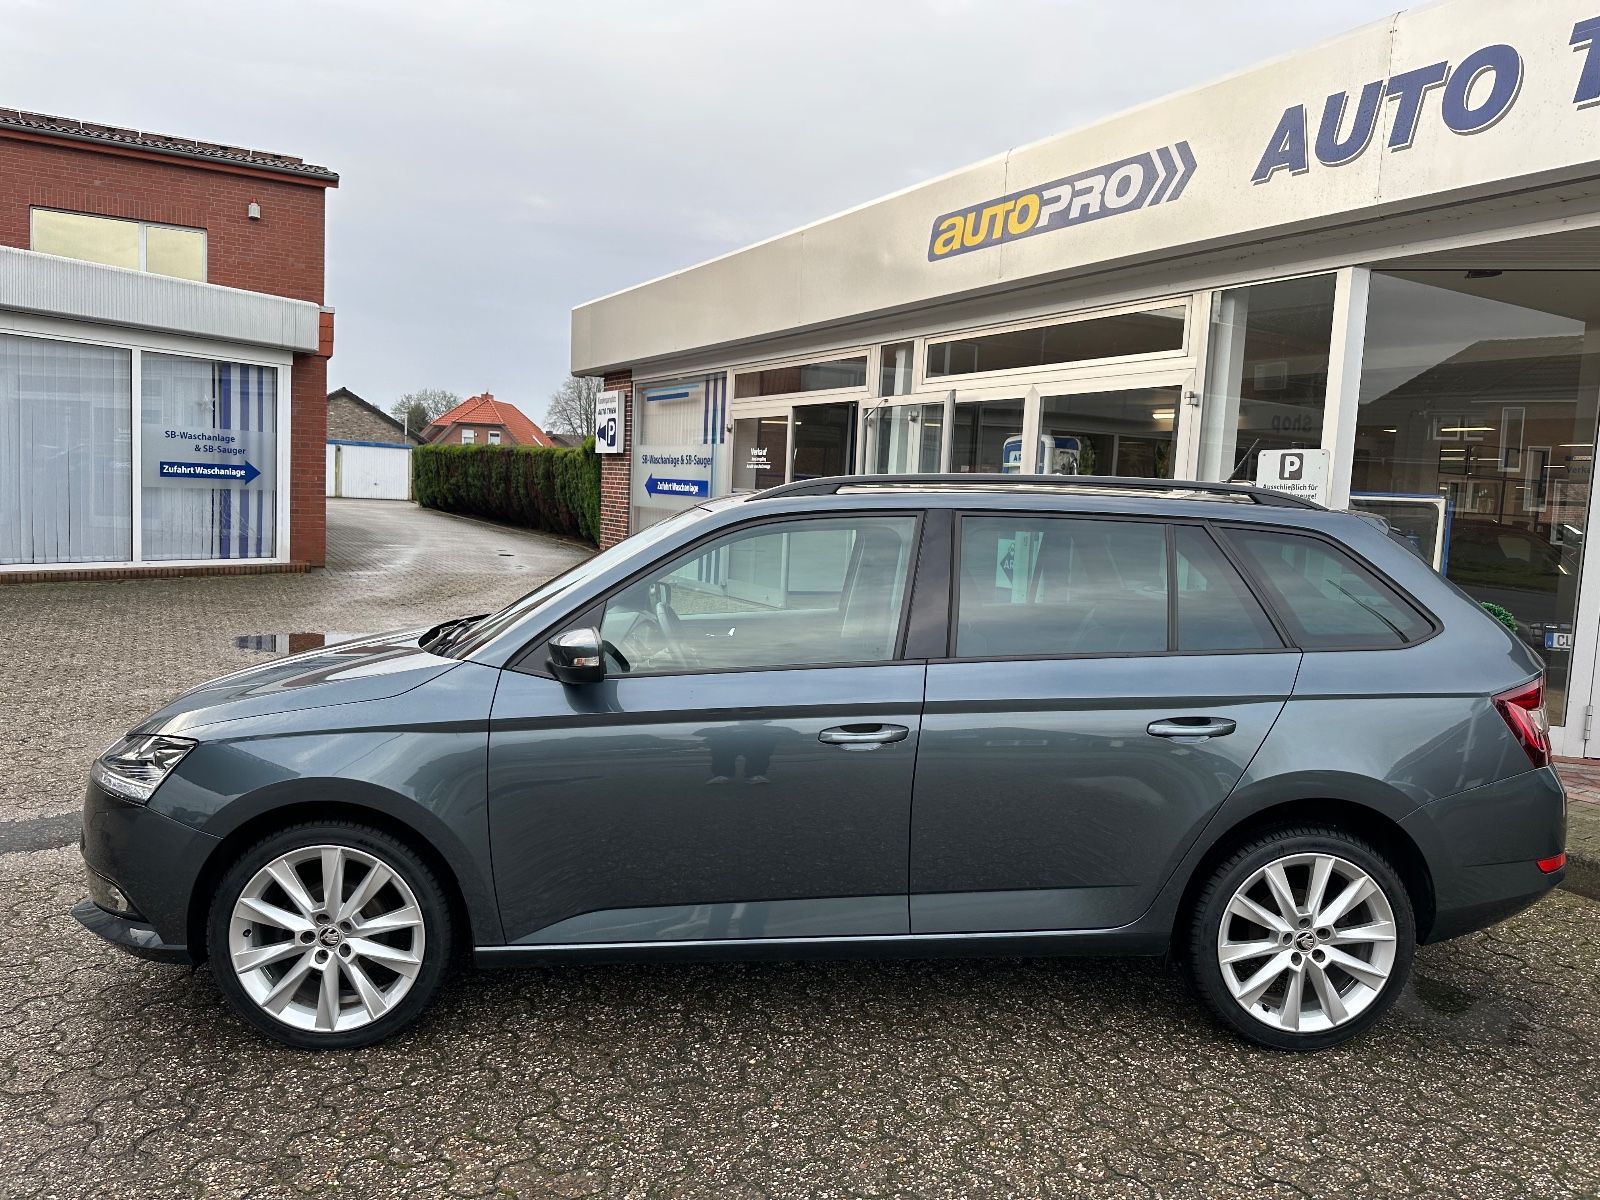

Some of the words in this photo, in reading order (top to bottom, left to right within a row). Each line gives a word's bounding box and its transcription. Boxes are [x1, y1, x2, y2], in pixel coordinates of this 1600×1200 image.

[1252, 44, 1523, 184] AUTO
[164, 430, 236, 444] SB-Waschanlage
[194, 444, 202, 452] &
[203, 445, 246, 456] SB-Sauger
[641, 453, 680, 468] SB-Waschanlage
[680, 454, 685, 465] &
[685, 454, 713, 468] SB-Sauger
[1283, 455, 1301, 478] P
[163, 465, 195, 474] Zufahrt
[195, 466, 246, 477] Waschanlage
[1263, 483, 1307, 491] Ausschließlich
[1307, 483, 1318, 491] für
